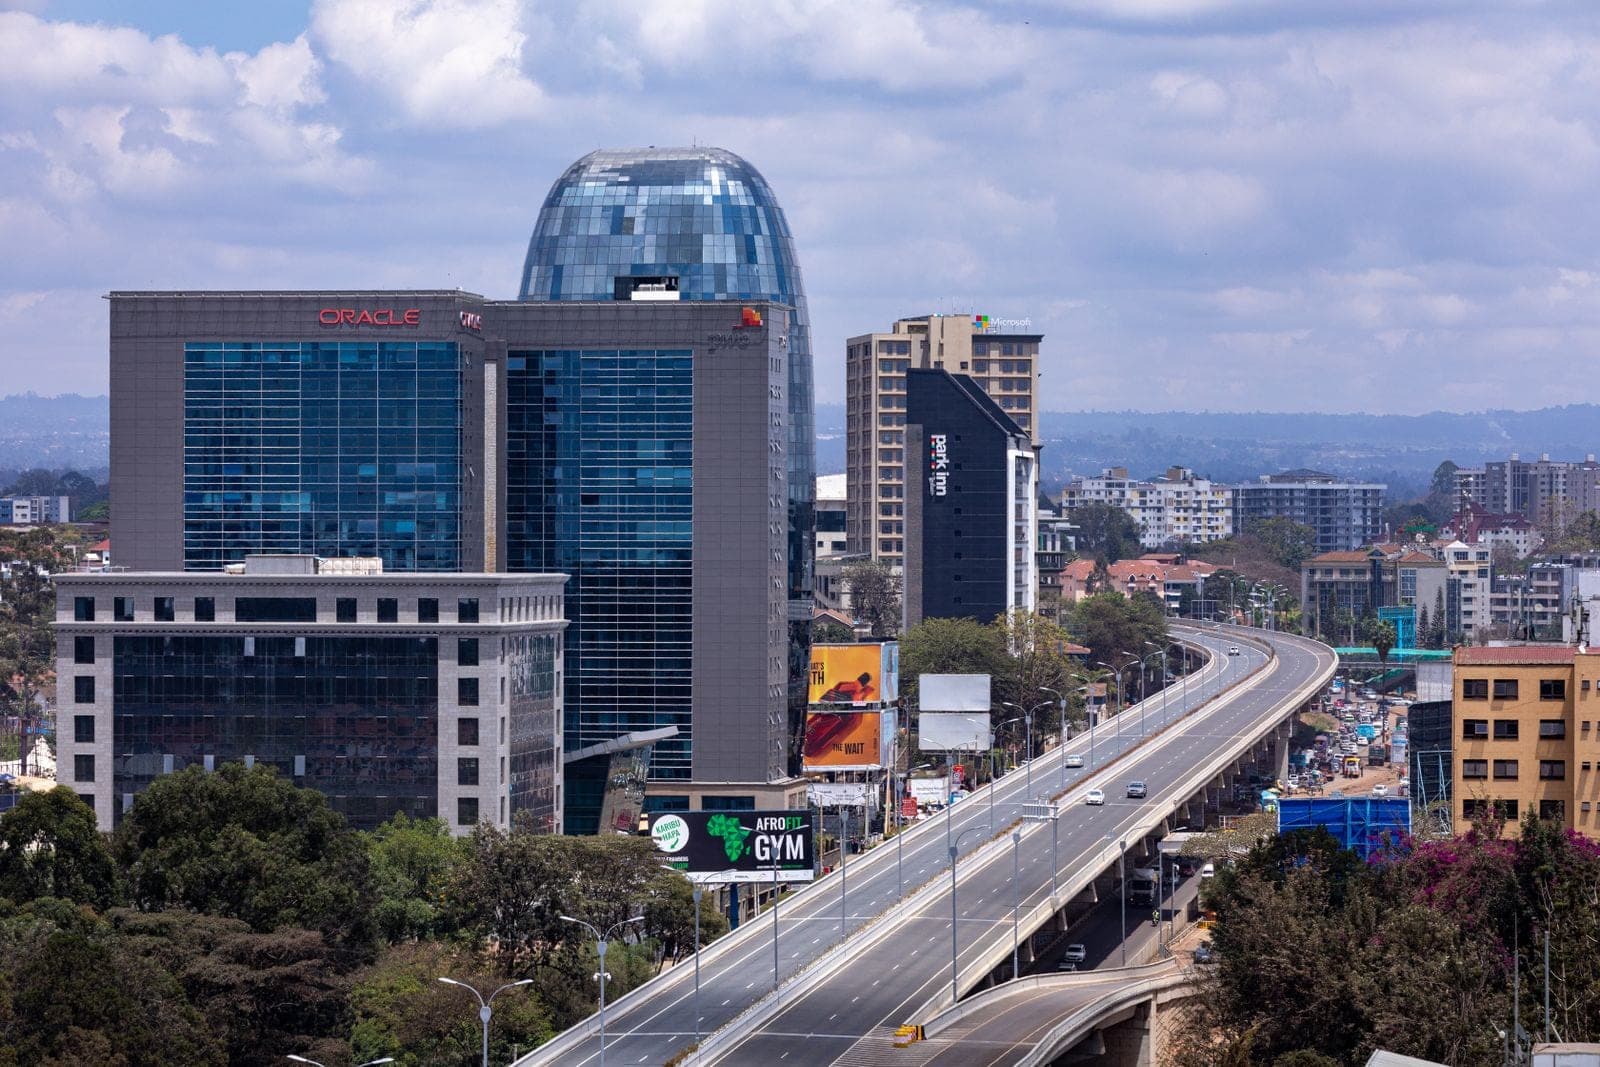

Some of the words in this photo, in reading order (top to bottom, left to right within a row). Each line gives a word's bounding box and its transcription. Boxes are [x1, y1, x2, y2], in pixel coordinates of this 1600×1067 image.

[319, 308, 421, 325] ORACLE
[990, 317, 1032, 327] Microsoft
[931, 434, 950, 470] park
[935, 471, 950, 497] inn
[832, 742, 843, 752] THE
[844, 742, 865, 755] WAIT
[655, 819, 681, 833] KARIBU
[756, 816, 803, 831] AFROFIT
[662, 829, 681, 841] HAPA
[755, 834, 804, 861] GYM
